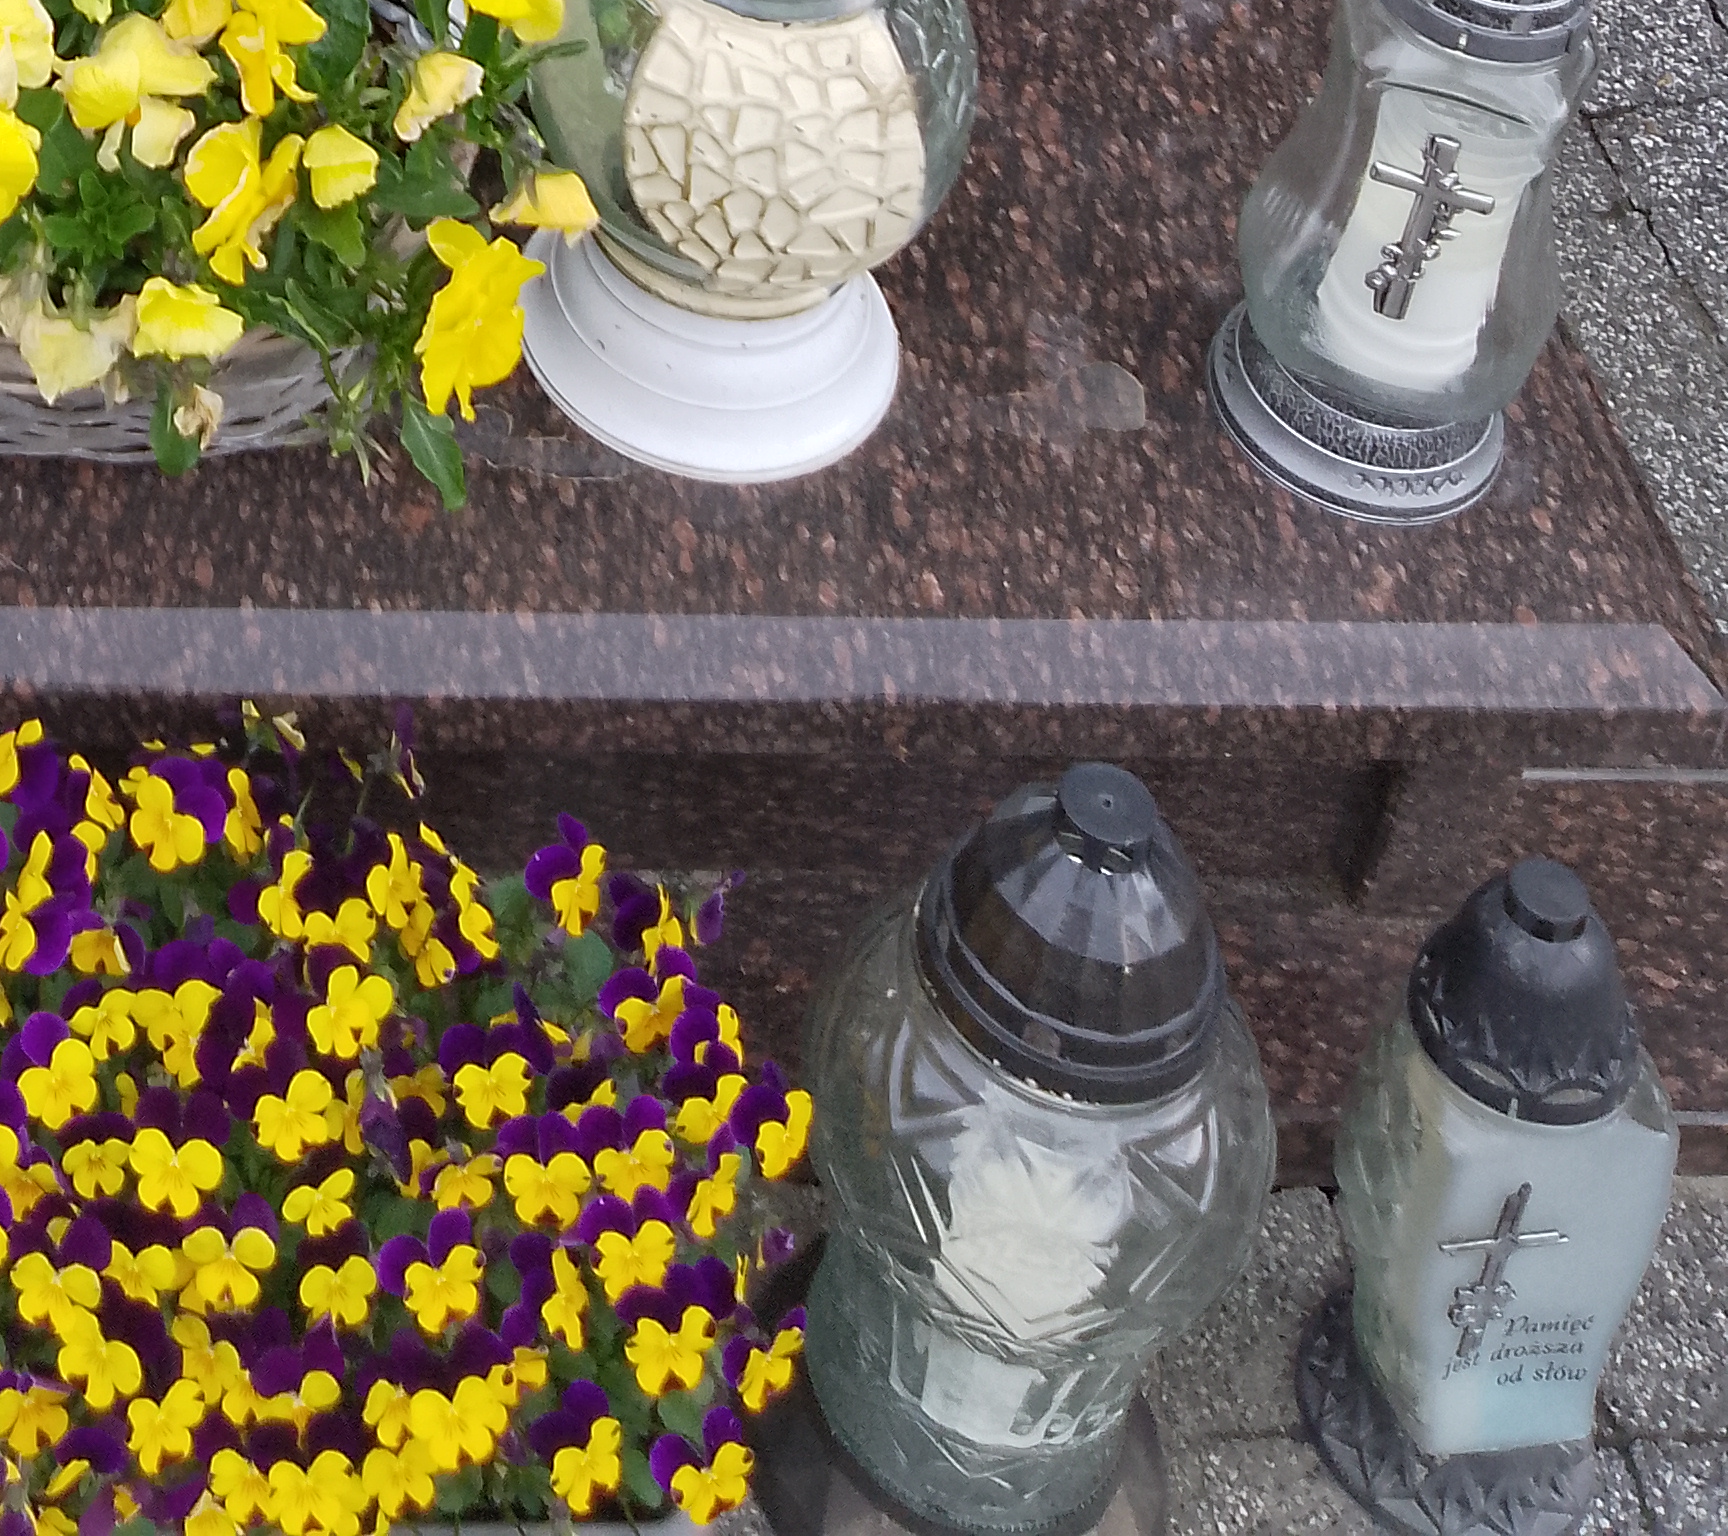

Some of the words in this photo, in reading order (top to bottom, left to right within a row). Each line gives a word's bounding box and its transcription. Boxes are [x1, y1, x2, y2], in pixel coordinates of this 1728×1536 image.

[1504, 1313, 1595, 1337] Pamięć
[1441, 1351, 1480, 1381] jest
[1489, 1342, 1585, 1362] droższa
[1496, 1364, 1525, 1386] od
[1532, 1361, 1588, 1382] słów
